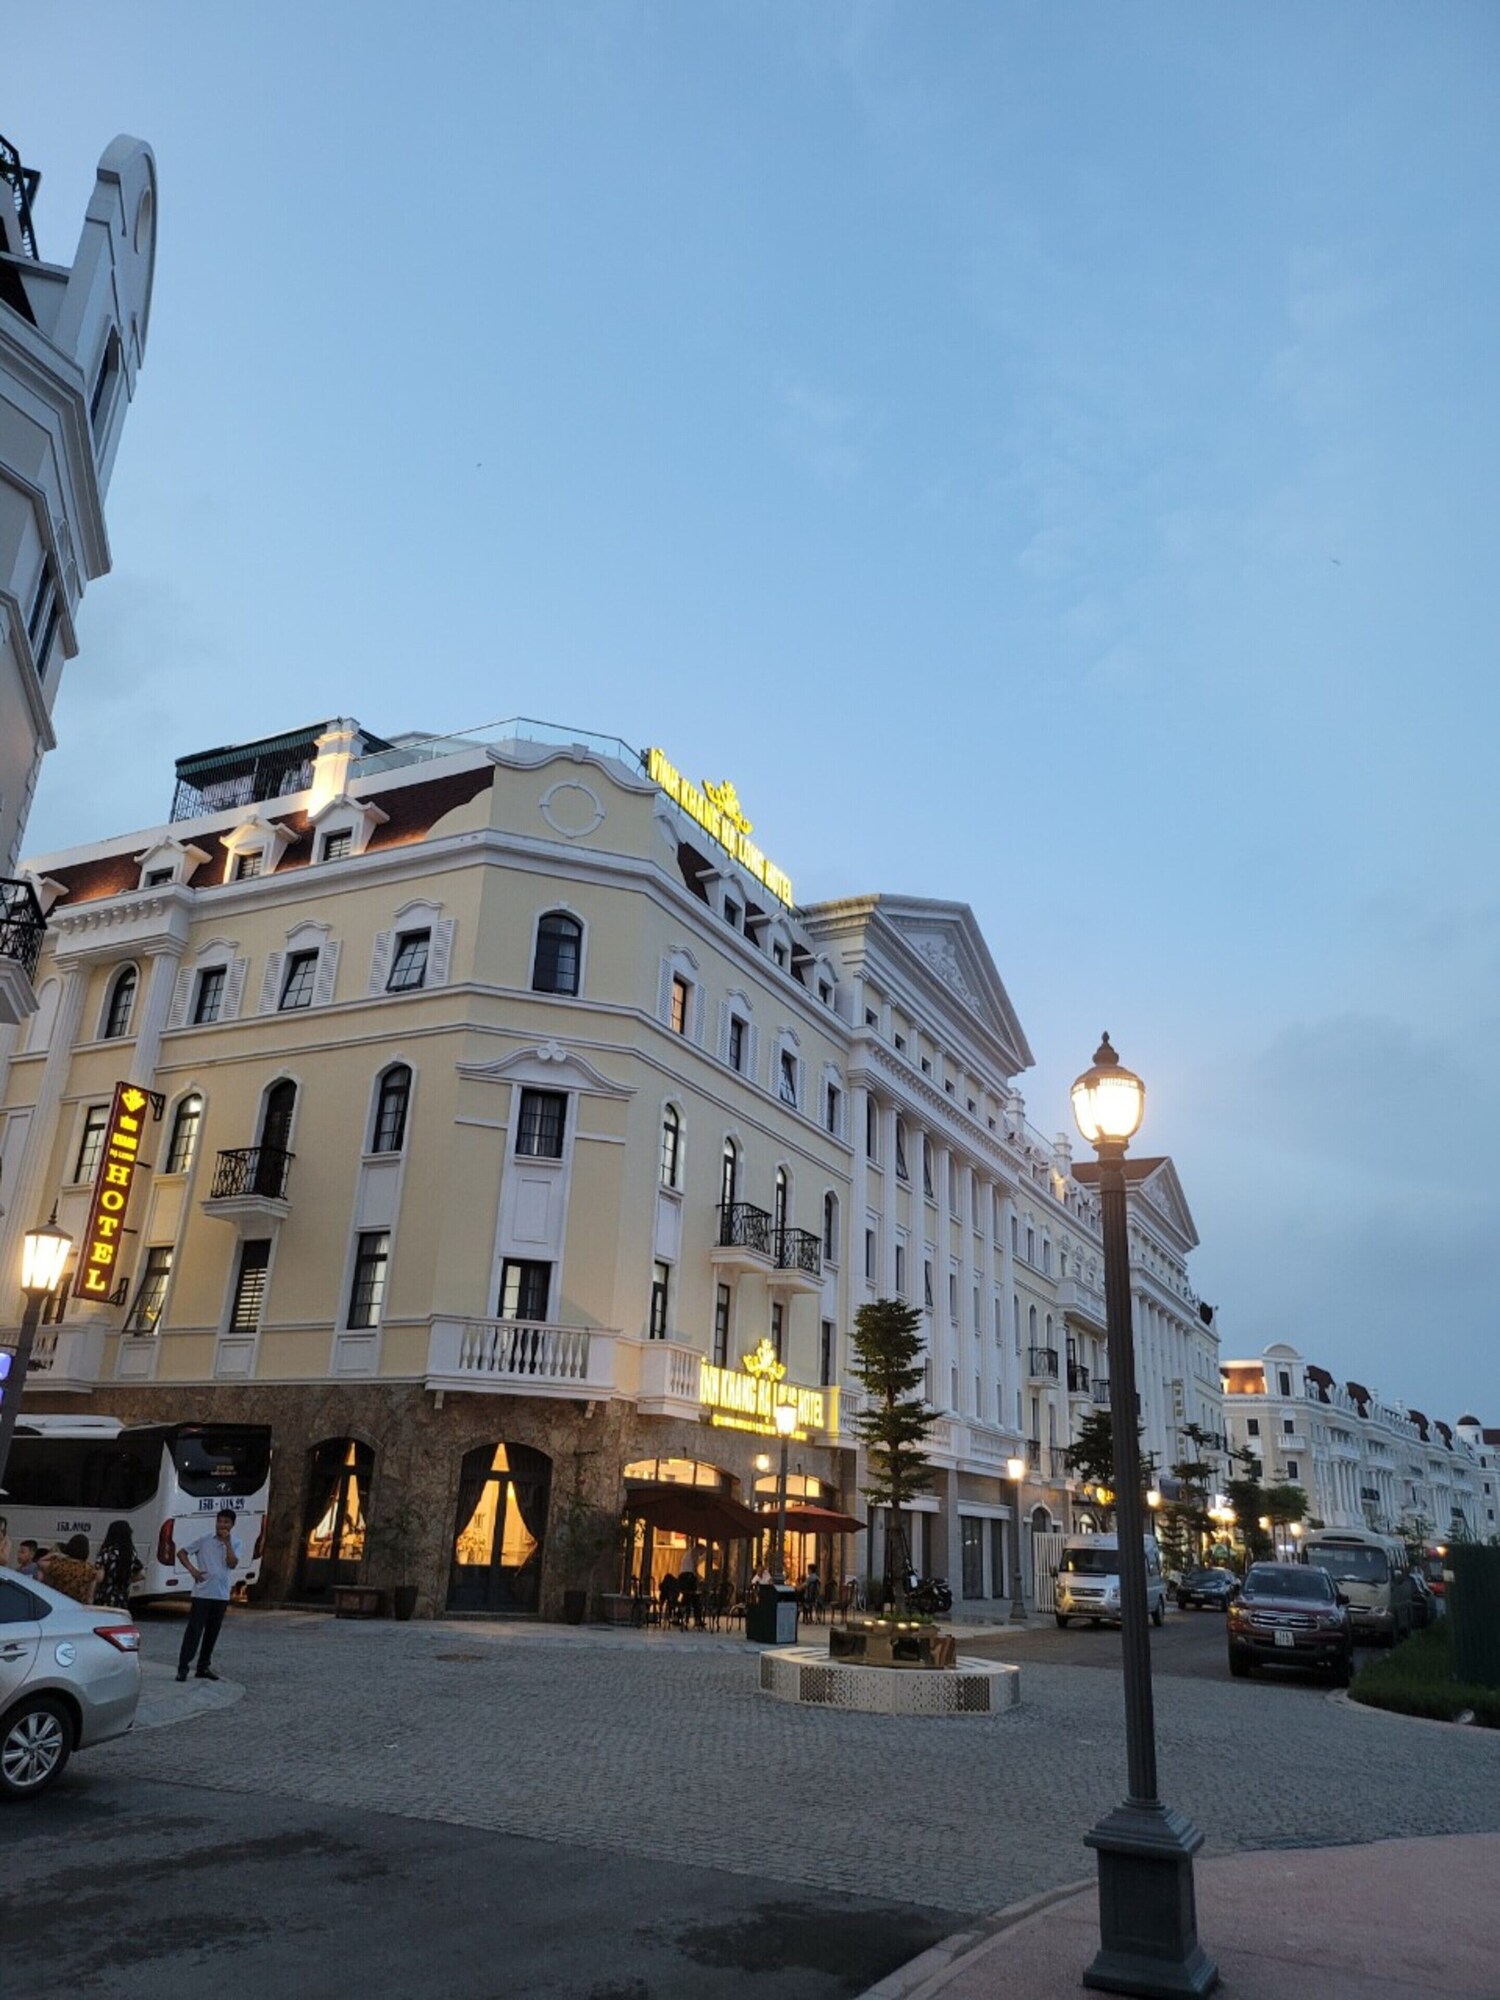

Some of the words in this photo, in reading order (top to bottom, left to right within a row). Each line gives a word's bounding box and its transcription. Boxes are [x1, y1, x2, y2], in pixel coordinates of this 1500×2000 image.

[680, 778, 721, 842] KHANG
[738, 834, 765, 881] LONG
[765, 859, 795, 909] HOTEL
[85, 1163, 131, 1292] HOTEL
[720, 1368, 757, 1414] KHANG
[798, 1388, 825, 1429] HOTEL
